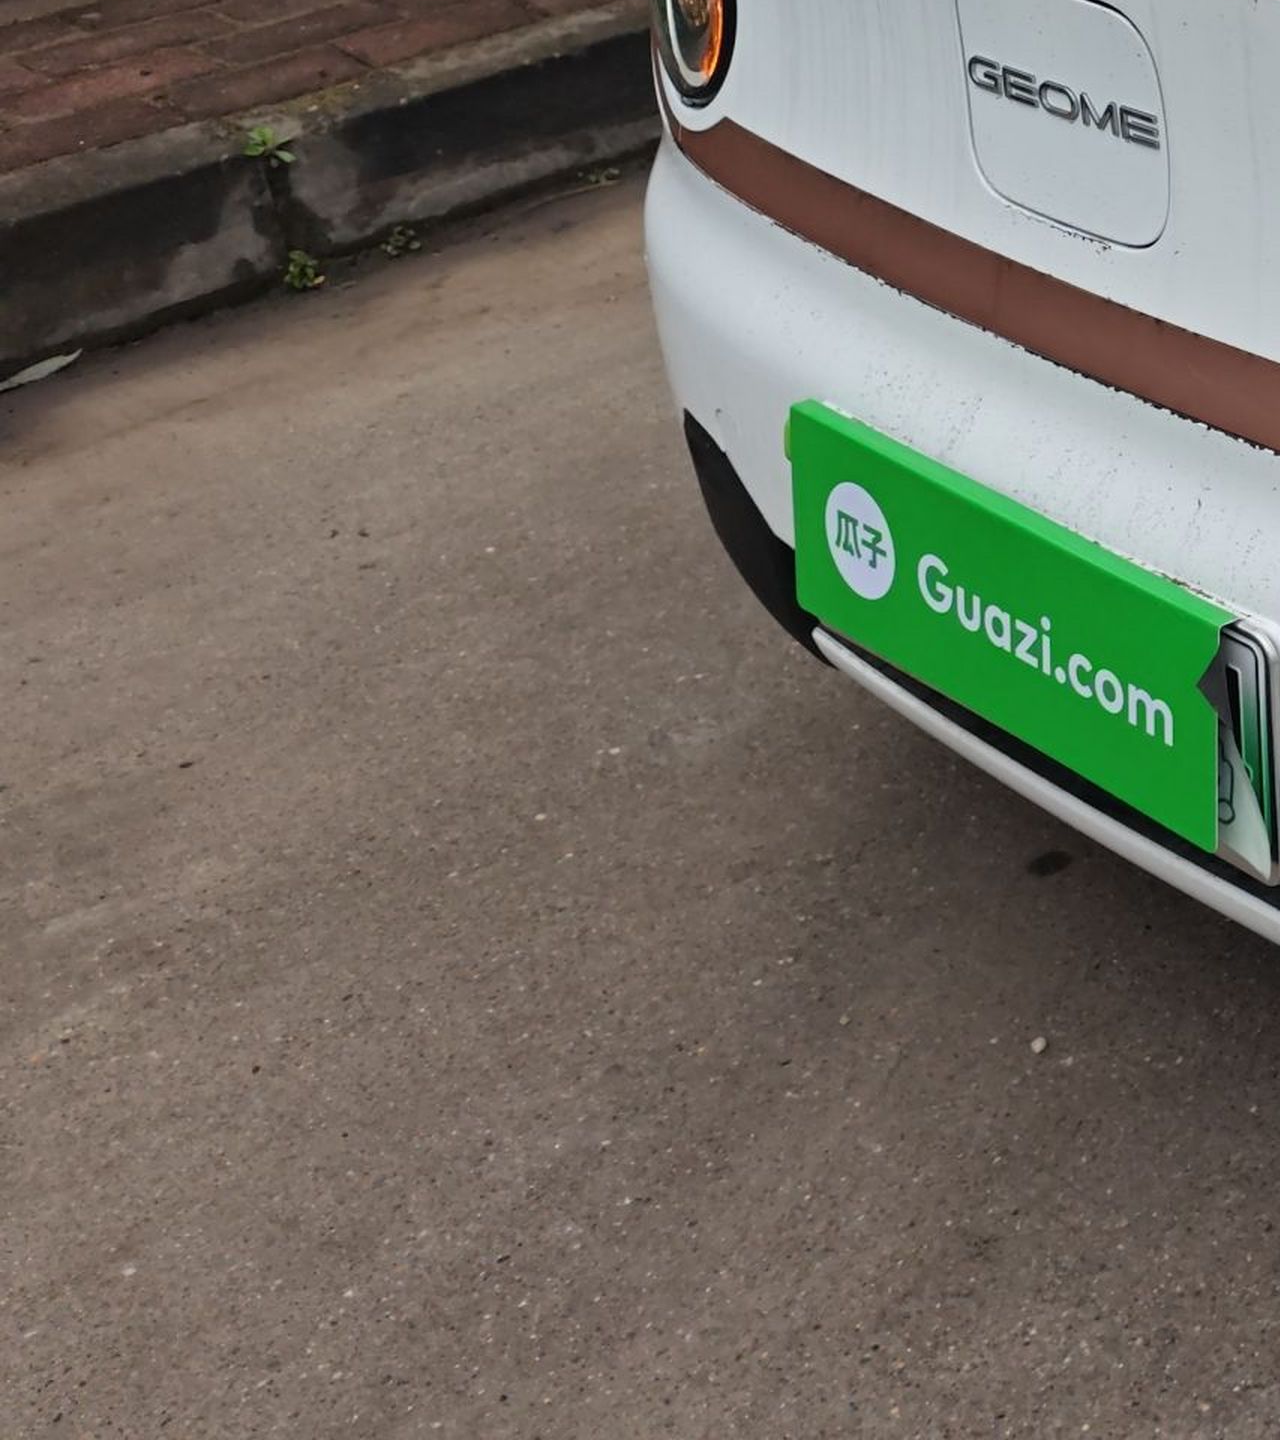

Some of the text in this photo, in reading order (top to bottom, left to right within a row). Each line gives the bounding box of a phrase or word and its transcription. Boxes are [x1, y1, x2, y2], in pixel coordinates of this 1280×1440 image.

[967, 54, 1161, 151] GEOME
[834, 509, 888, 569] 瓜子
[916, 553, 1175, 748] Guazi.com
